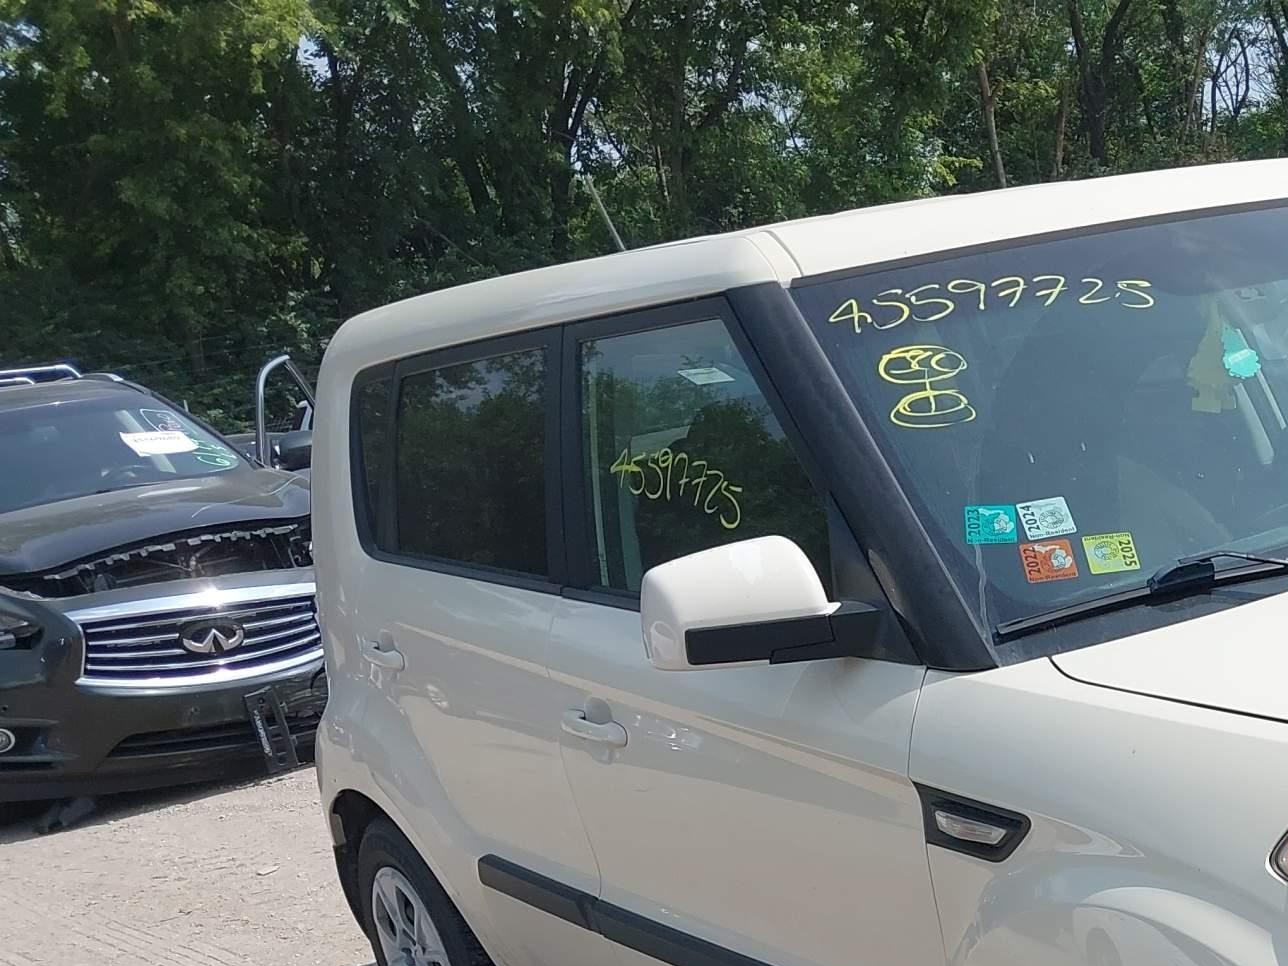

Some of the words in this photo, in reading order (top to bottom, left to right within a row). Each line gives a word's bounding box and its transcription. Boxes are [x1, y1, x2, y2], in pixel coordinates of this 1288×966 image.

[828, 275, 1155, 333] 45597725
[610, 447, 743, 529] 45597725
[967, 508, 981, 537] 2023
[1019, 504, 1041, 533] 2024
[1022, 546, 1042, 576] 2022
[1118, 538, 1138, 567] 2025
